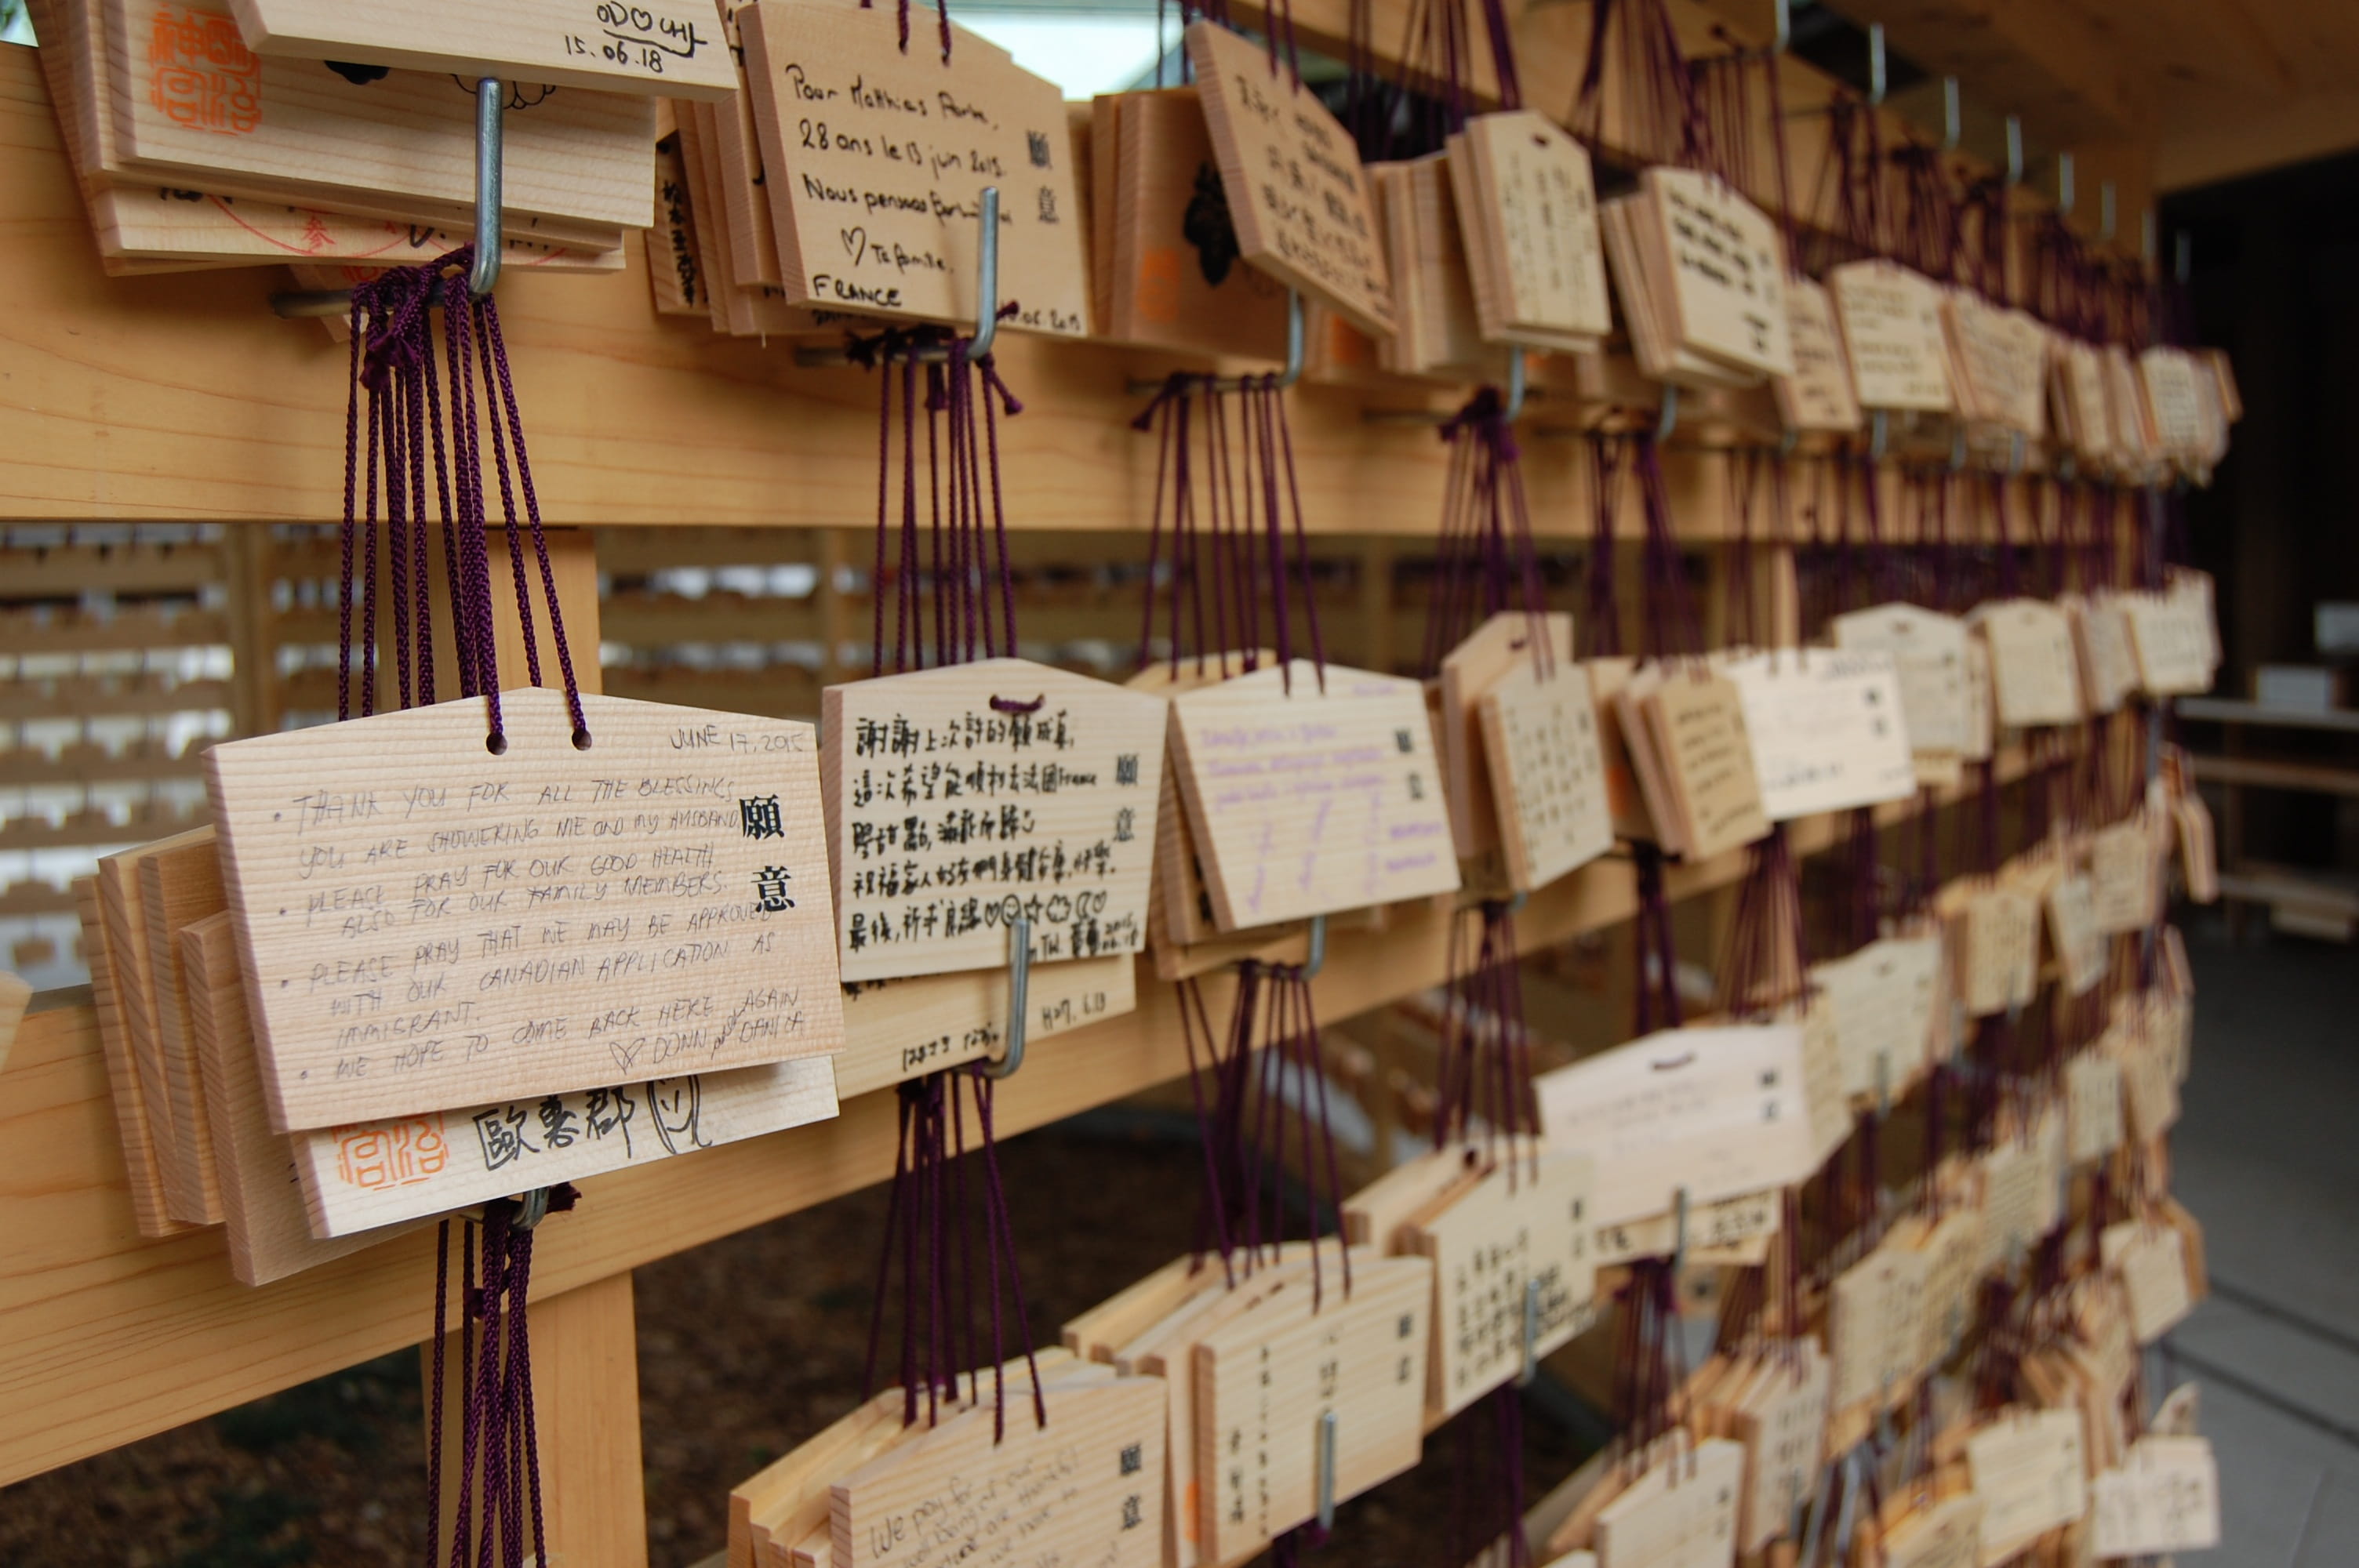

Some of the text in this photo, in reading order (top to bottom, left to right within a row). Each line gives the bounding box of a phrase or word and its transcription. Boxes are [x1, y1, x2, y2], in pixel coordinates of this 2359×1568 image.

[785, 62, 839, 101] Pour
[798, 118, 831, 151] 28
[836, 132, 873, 157] ans
[881, 135, 903, 162] le
[801, 173, 859, 204] Nous
[812, 274, 903, 308] FRANCE
[671, 724, 720, 751] JUNE
[293, 788, 383, 837] THANK
[403, 783, 446, 819] YOU
[467, 780, 510, 813] FOR
[537, 784, 572, 805] ALL
[591, 778, 625, 804] THE
[299, 845, 345, 880] YOU
[365, 837, 409, 867] ARE
[428, 817, 540, 854] SHOWERING
[555, 815, 588, 839] ME
[739, 793, 796, 913] 願意
[307, 842, 715, 929] PLEASE PRAY FOR OUR GOOD HEALTH
[341, 909, 396, 939] ALSO
[407, 897, 452, 924] FOR
[469, 889, 508, 914] OUR
[525, 880, 608, 910] FAMILY
[308, 903, 773, 994] PLEASE PRAY THAT WE MAY BE APPROVED
[330, 931, 776, 1018] WITH OUR CANADIAN APPLICATION AS
[335, 987, 800, 1080] WE HOPE TO COME BACK HERE AGAIN
[870, 1514, 905, 1560] We
